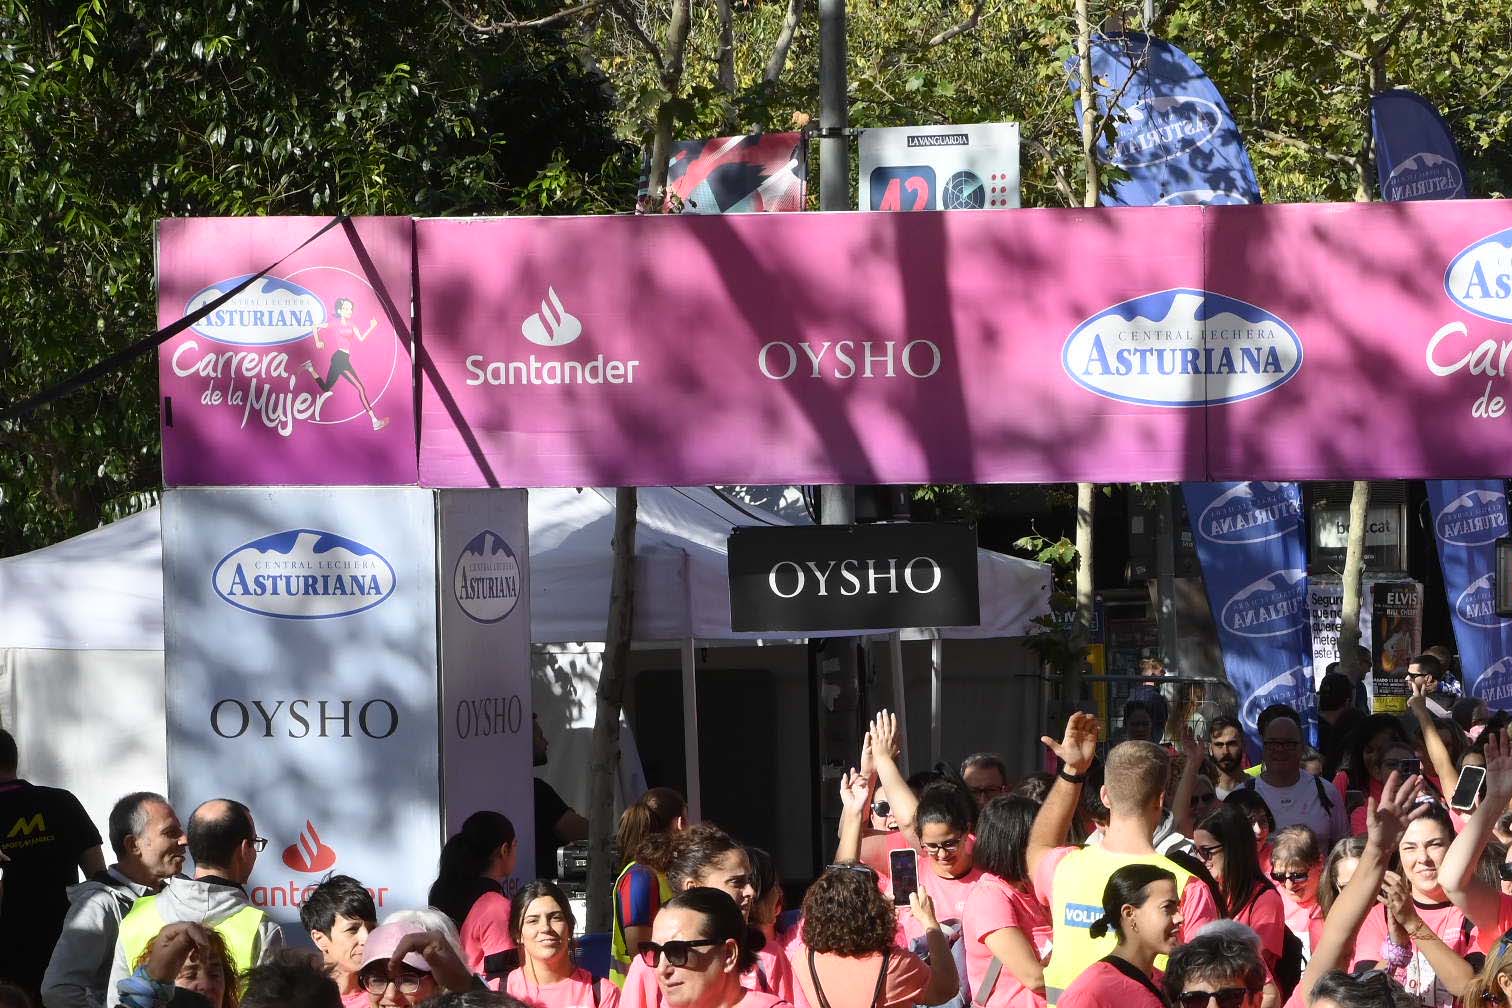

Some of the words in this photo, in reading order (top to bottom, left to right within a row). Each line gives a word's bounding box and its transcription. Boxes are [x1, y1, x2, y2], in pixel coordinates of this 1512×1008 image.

[918, 135, 968, 146] VANGUARDIA
[1118, 330, 1192, 341] CENTRAL
[1202, 328, 1275, 341] LECHERA
[172, 340, 290, 379] Carrera
[466, 354, 639, 386] Santander
[758, 338, 941, 380] OYSHO
[1083, 333, 1284, 376] ASTURIANA
[201, 379, 223, 406] de
[228, 381, 242, 407] la
[241, 369, 333, 437] Mujer
[1472, 381, 1506, 418] de
[228, 563, 383, 597] ASTURIANA
[254, 560, 312, 569] CENTRAL
[318, 559, 377, 569] LECHERA
[768, 556, 942, 598] OYSHO
[460, 565, 517, 600] ASTURIANA
[1387, 592, 1418, 605] ELVIS
[1313, 610, 1328, 620] que
[1314, 649, 1333, 659] este
[210, 699, 399, 740] OYSHO
[456, 695, 522, 740] OYSHO
